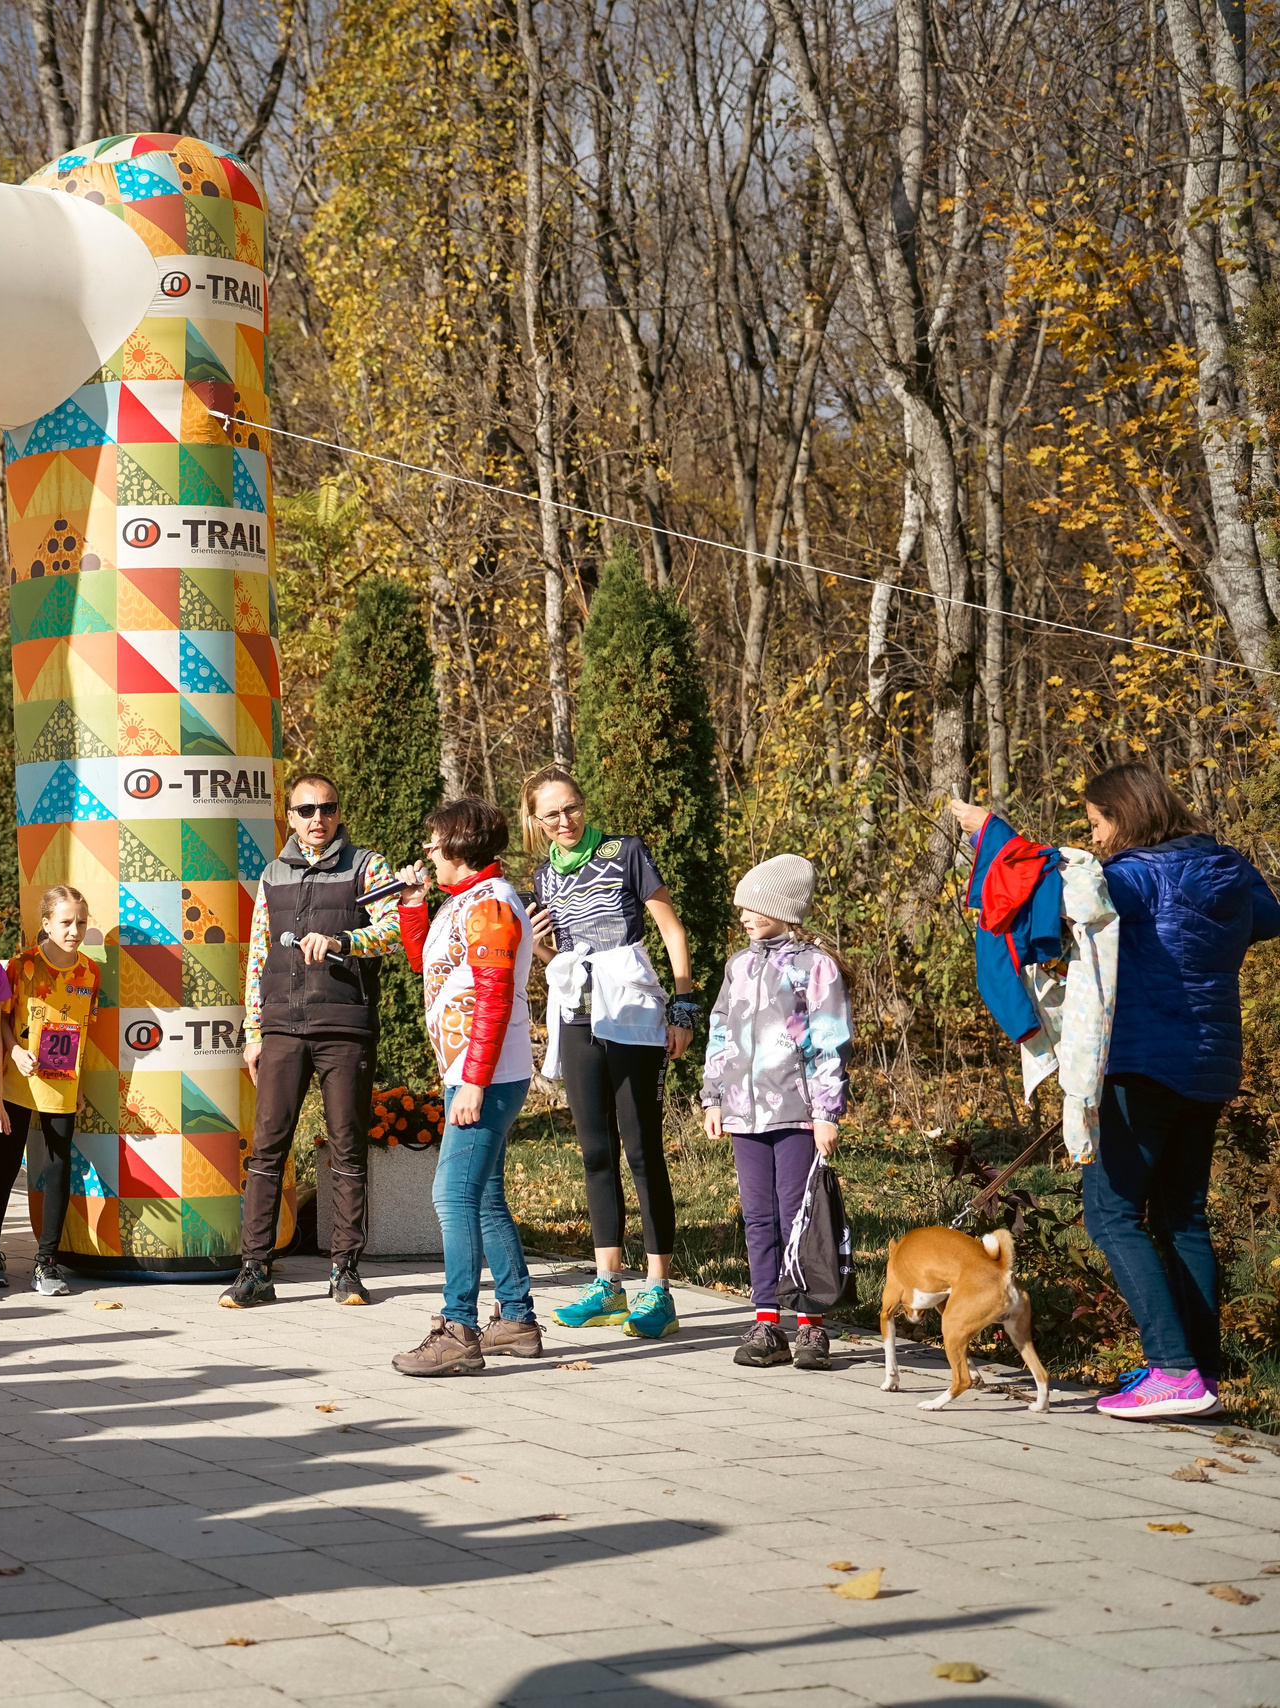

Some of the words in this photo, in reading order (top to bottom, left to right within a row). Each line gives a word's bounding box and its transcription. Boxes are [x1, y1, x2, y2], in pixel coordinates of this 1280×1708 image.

[191, 547, 266, 561] orienteering&trailrunning
[192, 797, 271, 806] orienteering&trailrunning
[780, 1033, 796, 1042] NEW
[48, 1034, 71, 1056] 20
[775, 1038, 794, 1051] YORK
